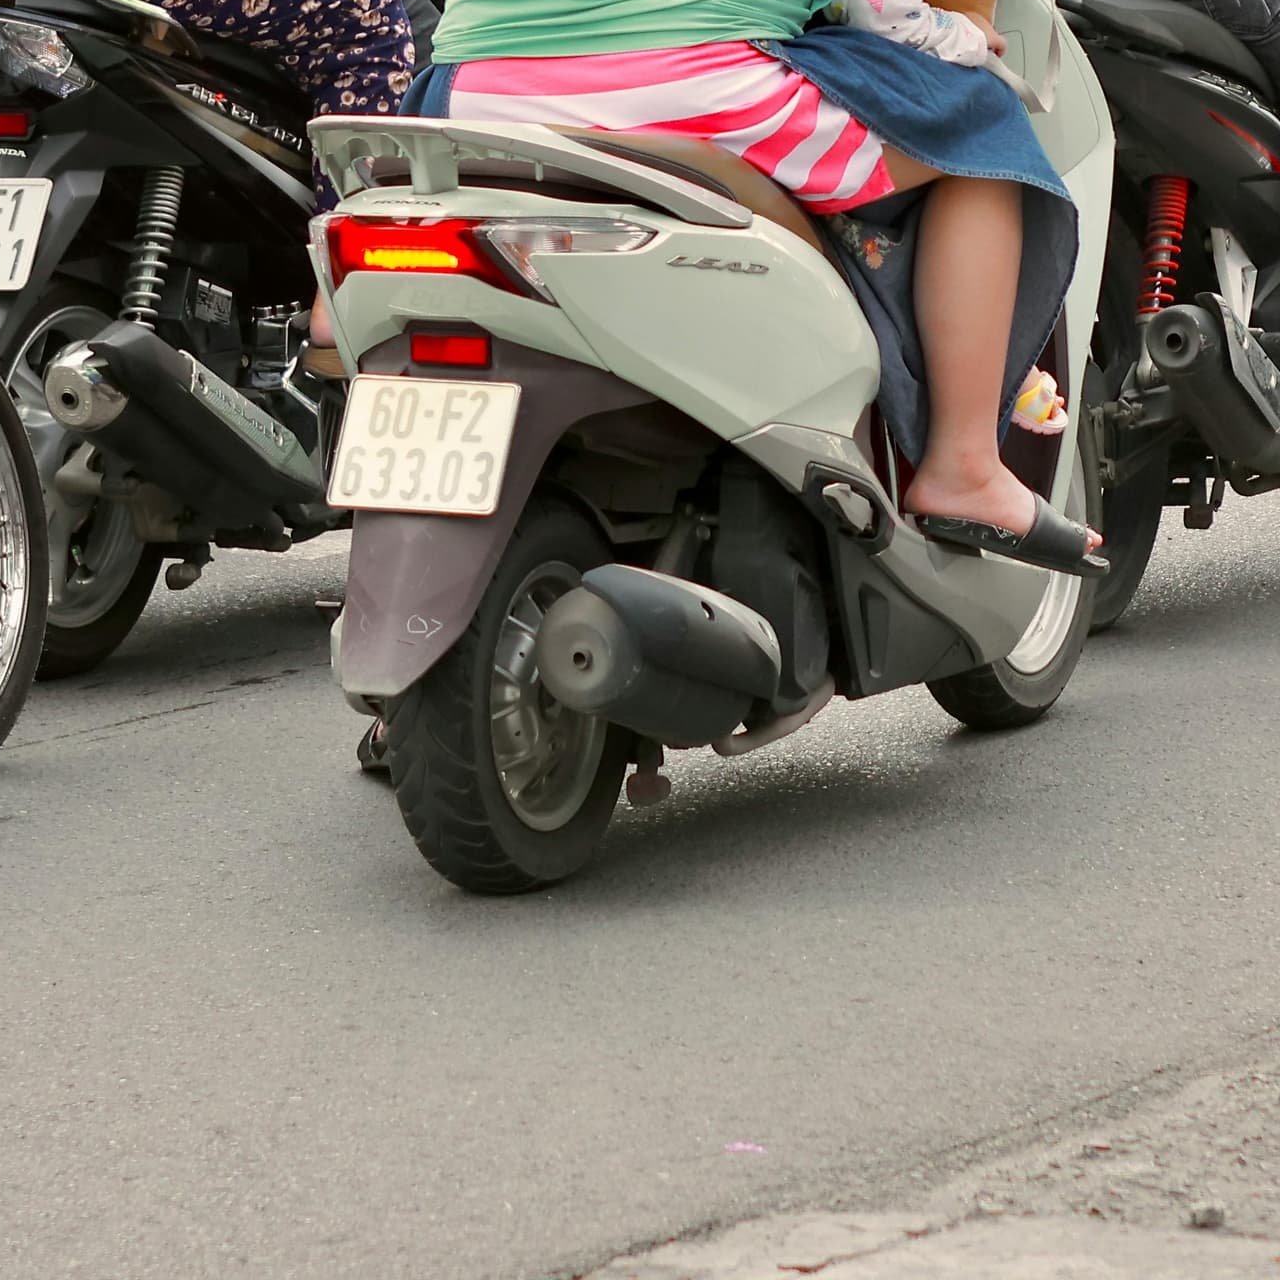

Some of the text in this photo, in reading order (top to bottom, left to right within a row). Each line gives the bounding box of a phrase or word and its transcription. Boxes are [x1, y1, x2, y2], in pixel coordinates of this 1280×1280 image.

[666, 254, 769, 273] LEAD
[369, 387, 490, 443] 60-F2
[340, 446, 494, 504] 633.03
